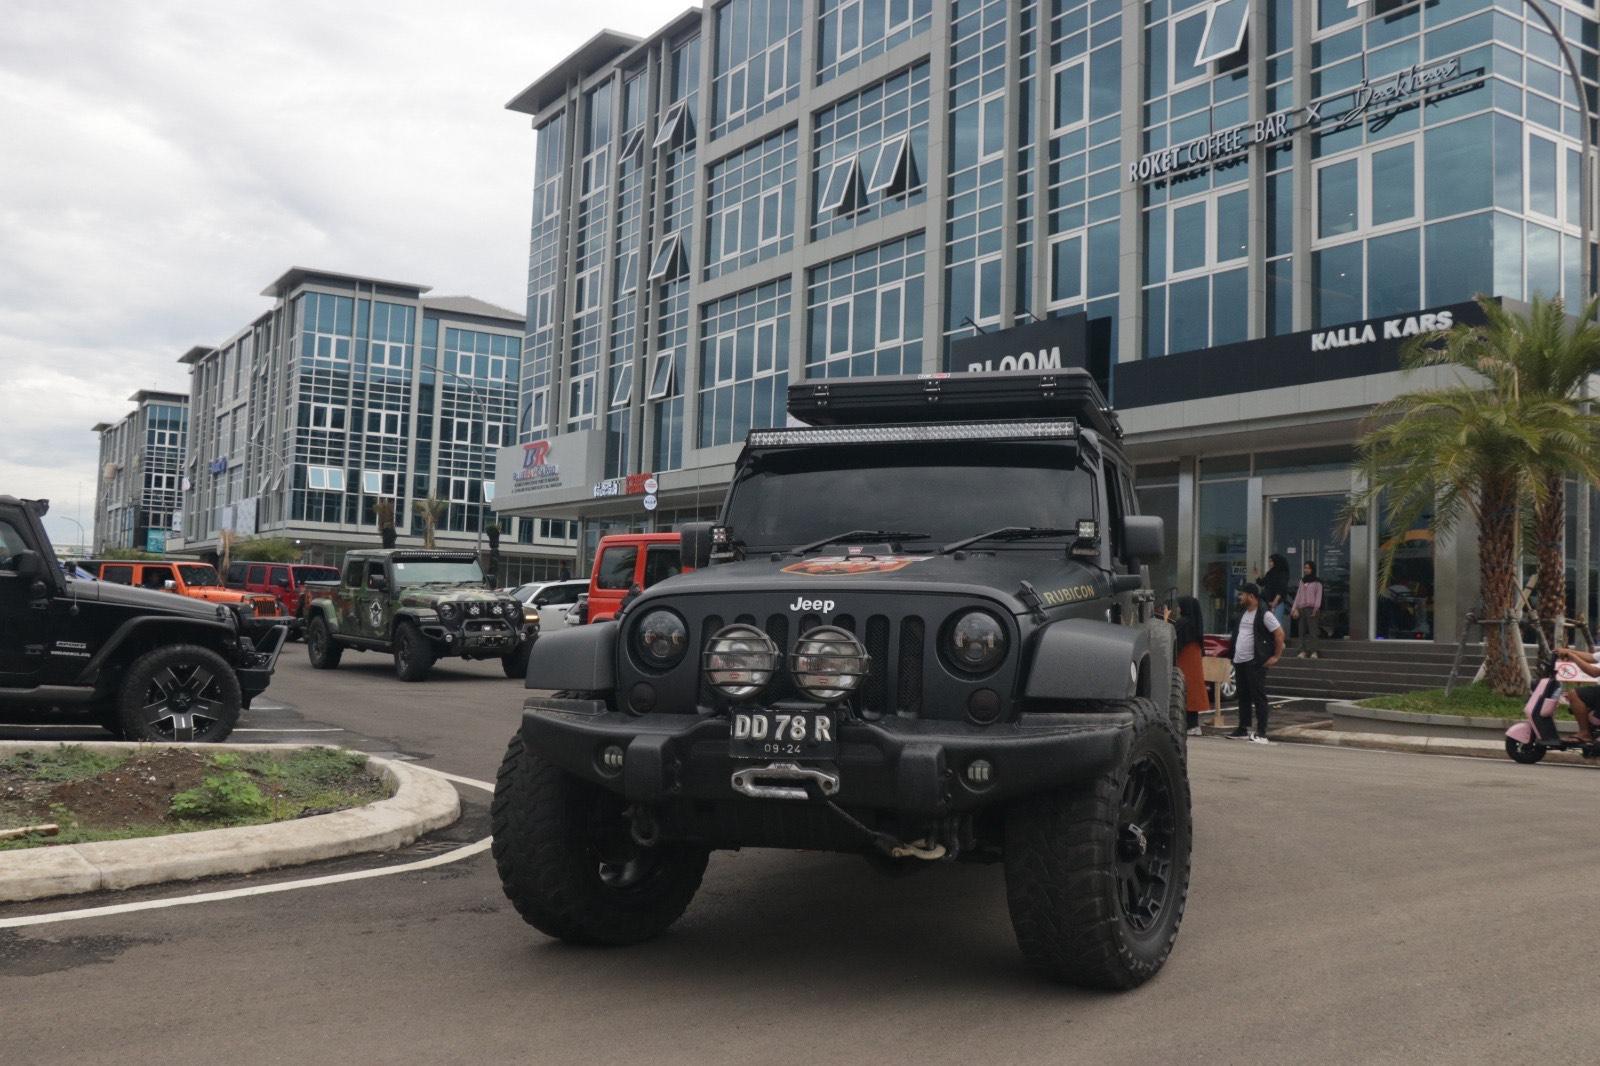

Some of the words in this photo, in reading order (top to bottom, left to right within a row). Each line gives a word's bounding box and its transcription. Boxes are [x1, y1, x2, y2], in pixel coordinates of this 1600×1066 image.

[1129, 147, 1181, 182] ROKET
[1187, 127, 1242, 164] COFFEE
[1255, 113, 1288, 143] BAR
[1311, 324, 1376, 352] KALLA
[1384, 310, 1454, 340] KARS
[790, 596, 835, 613] Jeep
[1043, 584, 1095, 604] RUBICON
[734, 714, 769, 740] DD
[774, 714, 806, 741] 78
[814, 715, 832, 741] R
